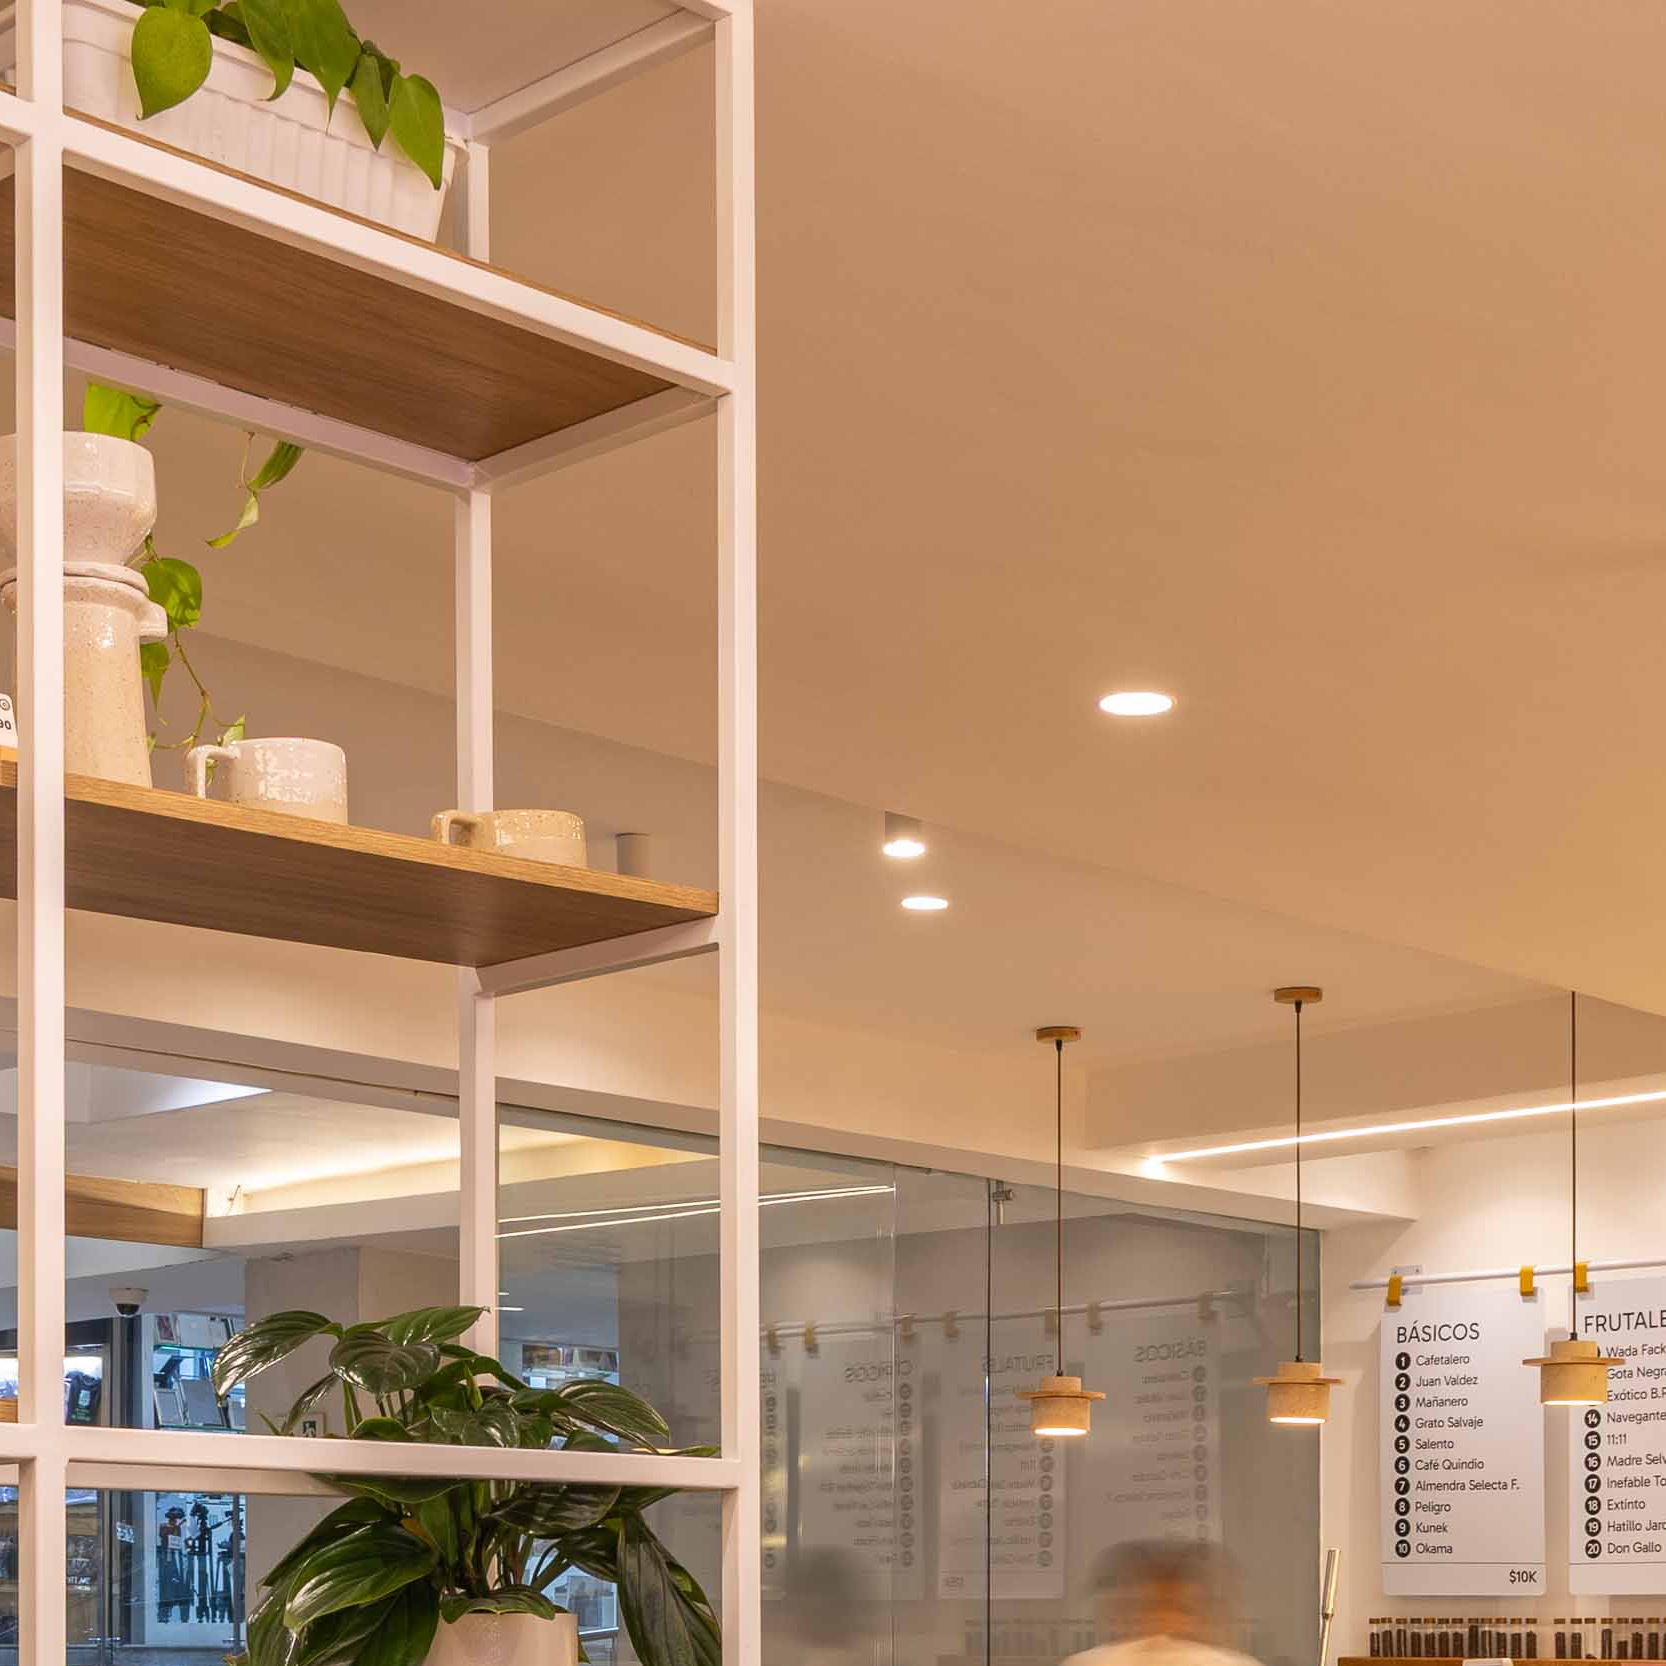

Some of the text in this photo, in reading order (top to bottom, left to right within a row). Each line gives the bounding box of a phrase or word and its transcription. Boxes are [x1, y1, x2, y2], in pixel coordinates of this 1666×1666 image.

[1397, 1321, 1480, 1343] BÁSICOS
[1606, 1347, 1637, 1358] Wada
[1641, 1343, 1666, 1355] Fack
[1416, 1355, 1470, 1366] Cafetalero
[1607, 1368, 1633, 1380] Gota
[1416, 1375, 1478, 1387] Juan Valdez
[1416, 1396, 1468, 1408] Mañanero
[1607, 1390, 1648, 1402] Exótico
[1415, 1417, 1483, 1430] Grato Salvaje
[1607, 1411, 1666, 1424] Navegante
[1415, 1439, 1454, 1450] Salento
[1607, 1434, 1627, 1445] 11:11
[1415, 1460, 1439, 1471] Café
[1607, 1456, 1642, 1467] Madre
[1416, 1480, 1466, 1491] Almendra
[1469, 1480, 1508, 1490] Selecta
[1607, 1476, 1650, 1489] Inefable
[1415, 1502, 1451, 1515] Peligro
[1607, 1499, 1646, 1510] Extinto
[1416, 1523, 1448, 1533] Kunek
[1607, 1521, 1642, 1532] Hatillo
[1416, 1544, 1453, 1554] Okama
[1608, 1542, 1662, 1554] Don Gallo
[1509, 1570, 1537, 1584] $10K
